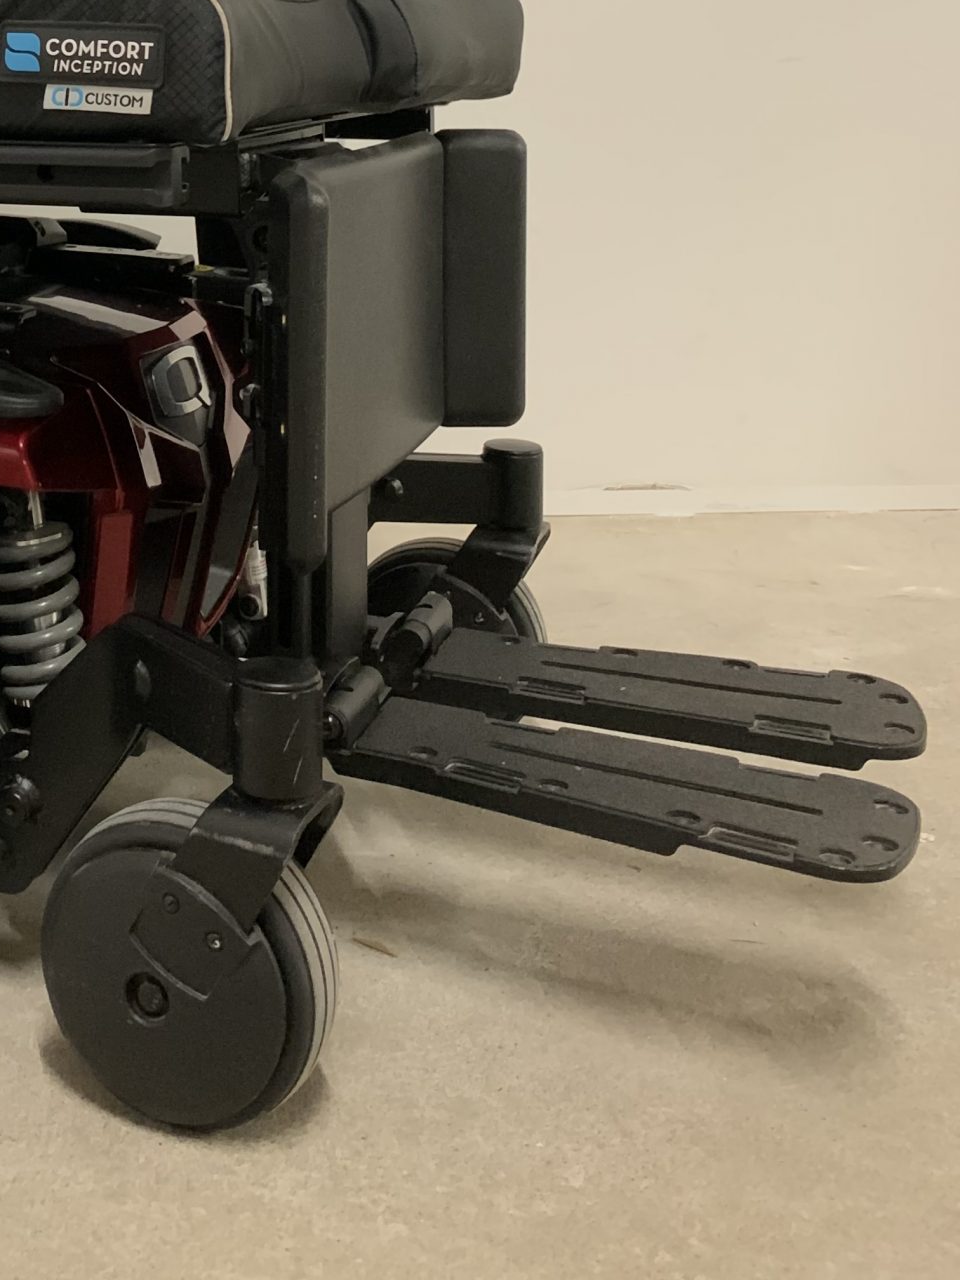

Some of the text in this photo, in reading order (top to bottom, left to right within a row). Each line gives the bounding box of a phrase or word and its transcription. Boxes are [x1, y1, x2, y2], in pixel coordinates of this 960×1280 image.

[45, 37, 155, 60] COMFORT
[53, 59, 144, 76] INCEPTION
[84, 91, 144, 108] CUSTOM
